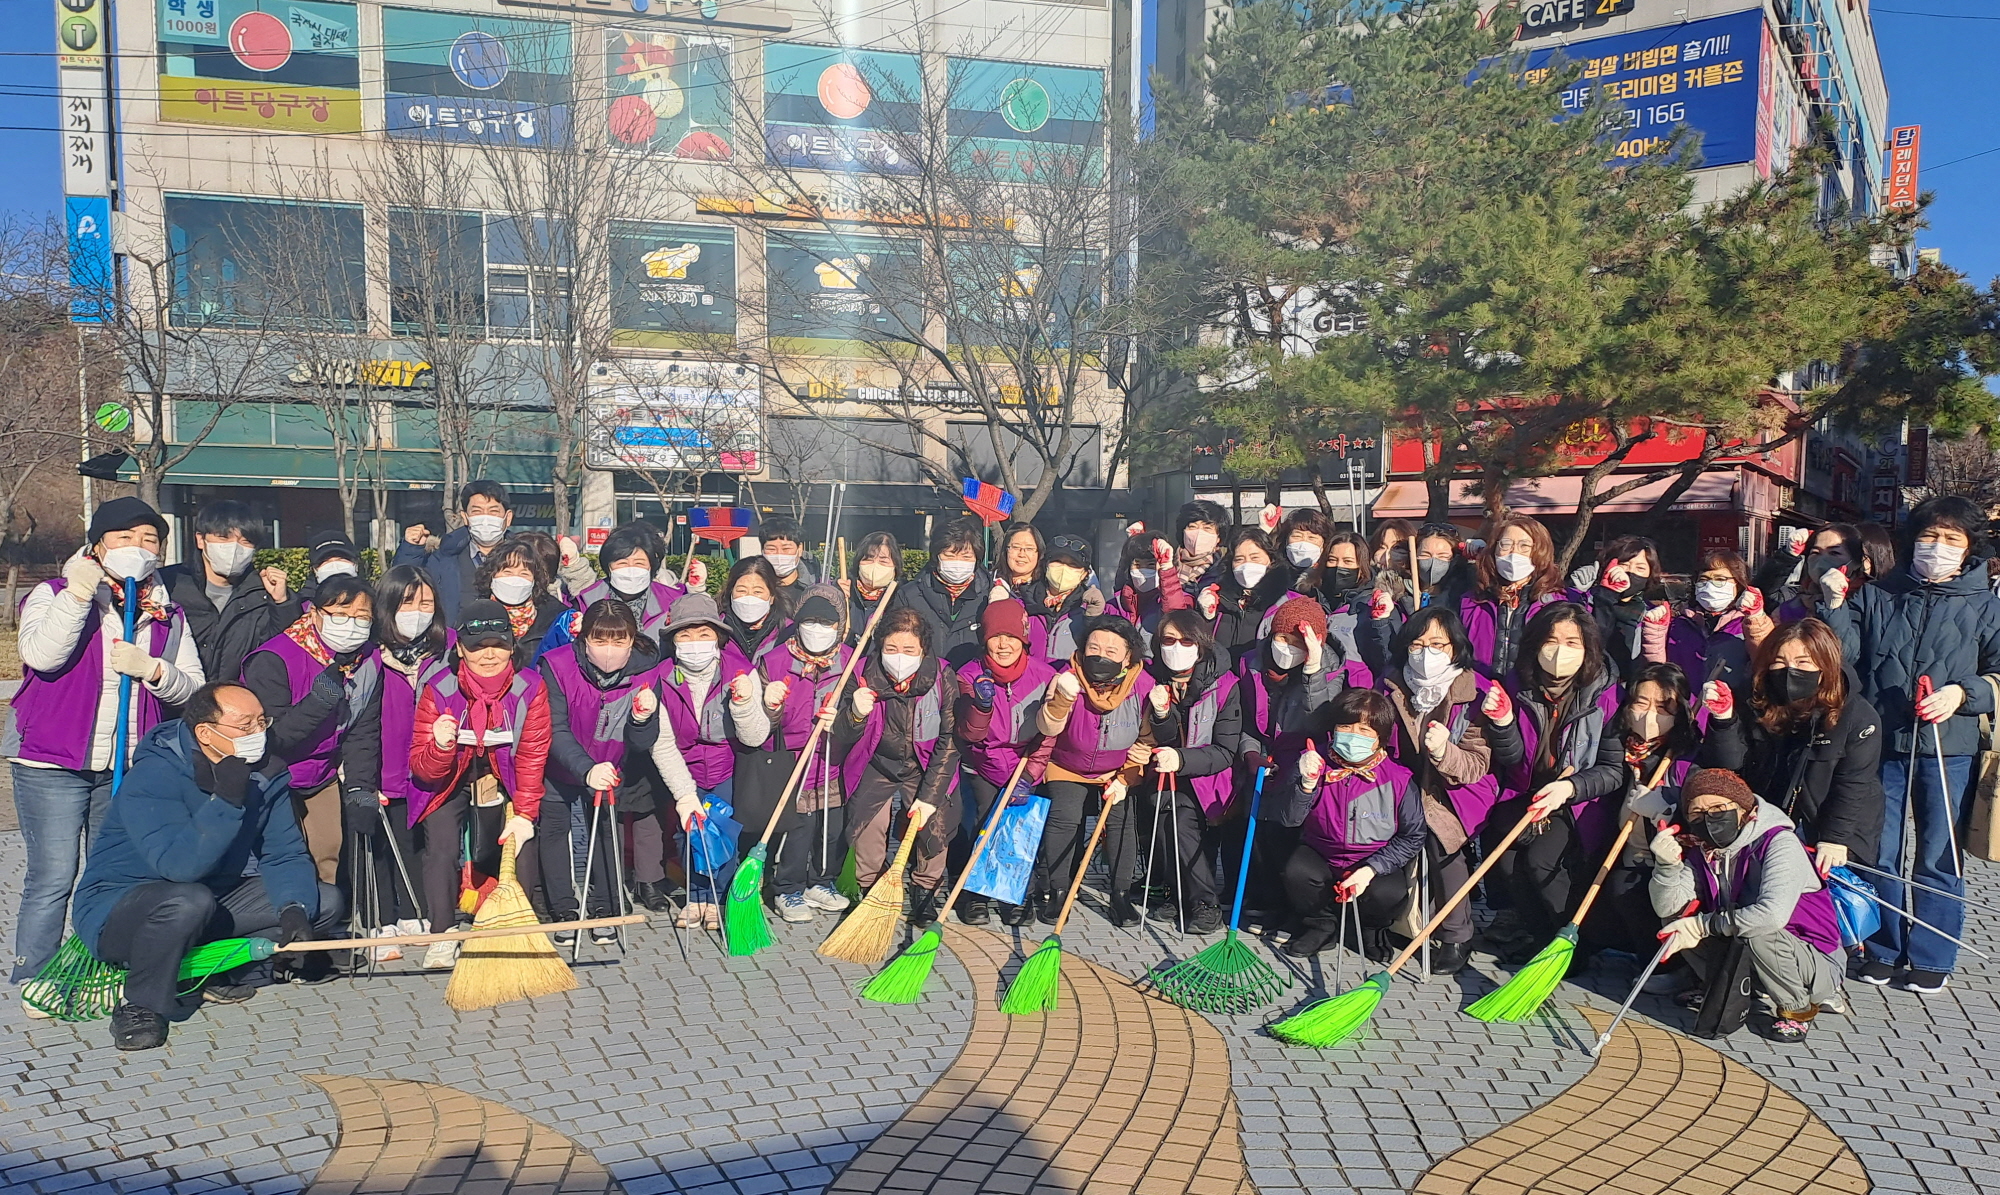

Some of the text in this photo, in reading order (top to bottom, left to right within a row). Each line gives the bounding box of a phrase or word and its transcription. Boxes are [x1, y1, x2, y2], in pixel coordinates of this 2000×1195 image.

[166, 19, 217, 35] 1000원
[1526, 0, 1585, 27] CAFE
[60, 56, 101, 64] 아트당구장
[1623, 44, 1679, 71] 비빔면
[1683, 34, 1731, 62] 출시!!
[1603, 71, 1678, 101] 프리미엄
[1683, 60, 1744, 89] 커플존
[195, 88, 330, 123] 아트당구장
[408, 104, 536, 139] 아트당구장
[1646, 102, 1685, 126] 16G
[68, 96, 93, 174] 찌개찌개
[786, 133, 900, 166] 아트당구장
[1895, 128, 1916, 148] 탑
[1893, 148, 1914, 200] 레지던스
[591, 429, 609, 441] 2F
